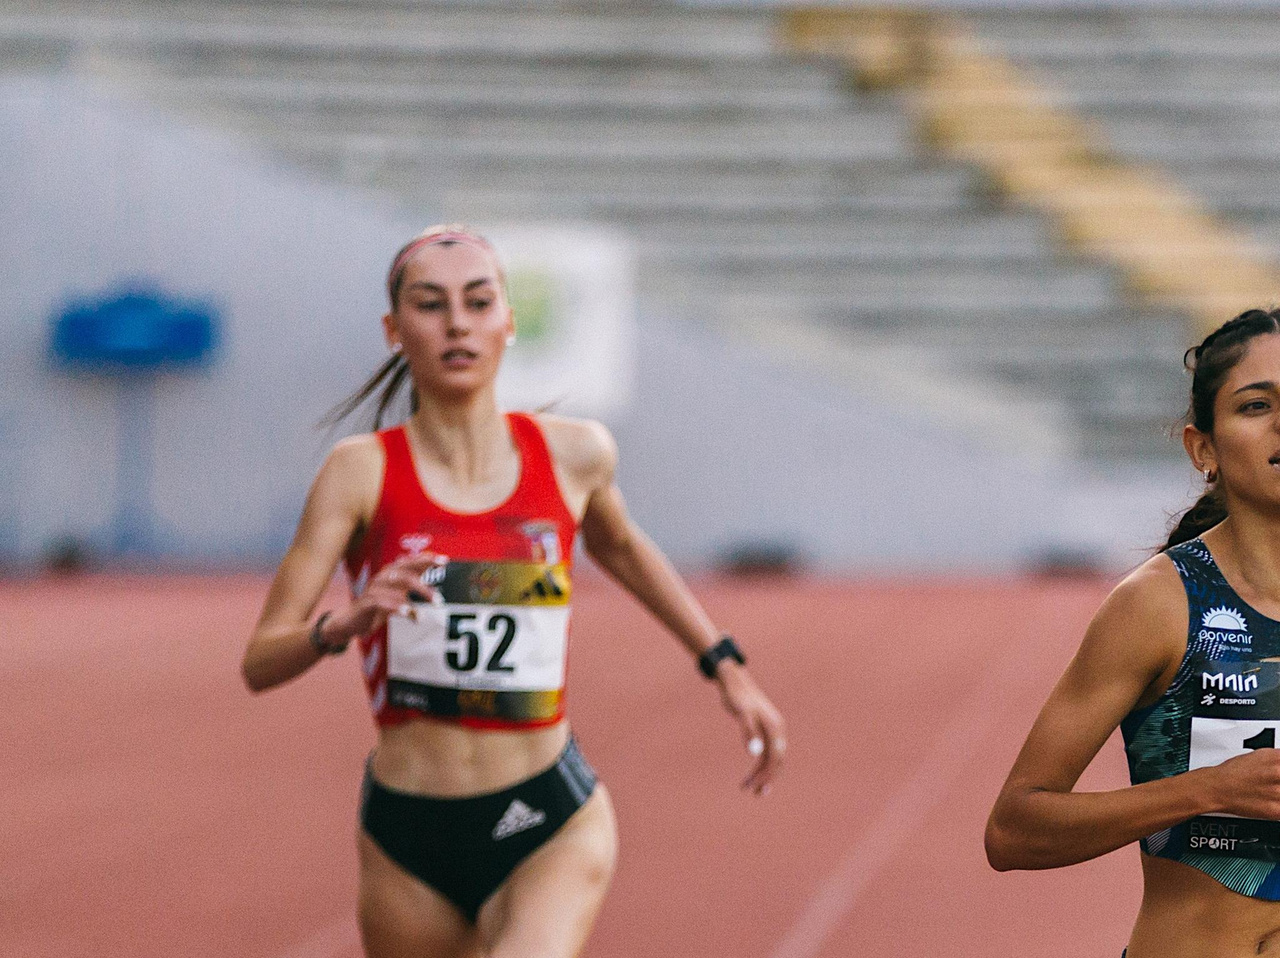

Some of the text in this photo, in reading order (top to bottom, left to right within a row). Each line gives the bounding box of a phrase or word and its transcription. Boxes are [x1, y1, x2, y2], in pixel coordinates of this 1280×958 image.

[444, 613, 517, 672] 52
[1199, 629, 1253, 645] porvenir
[1190, 822, 1239, 837] EVENT
[1189, 836, 1238, 850] SPORT
